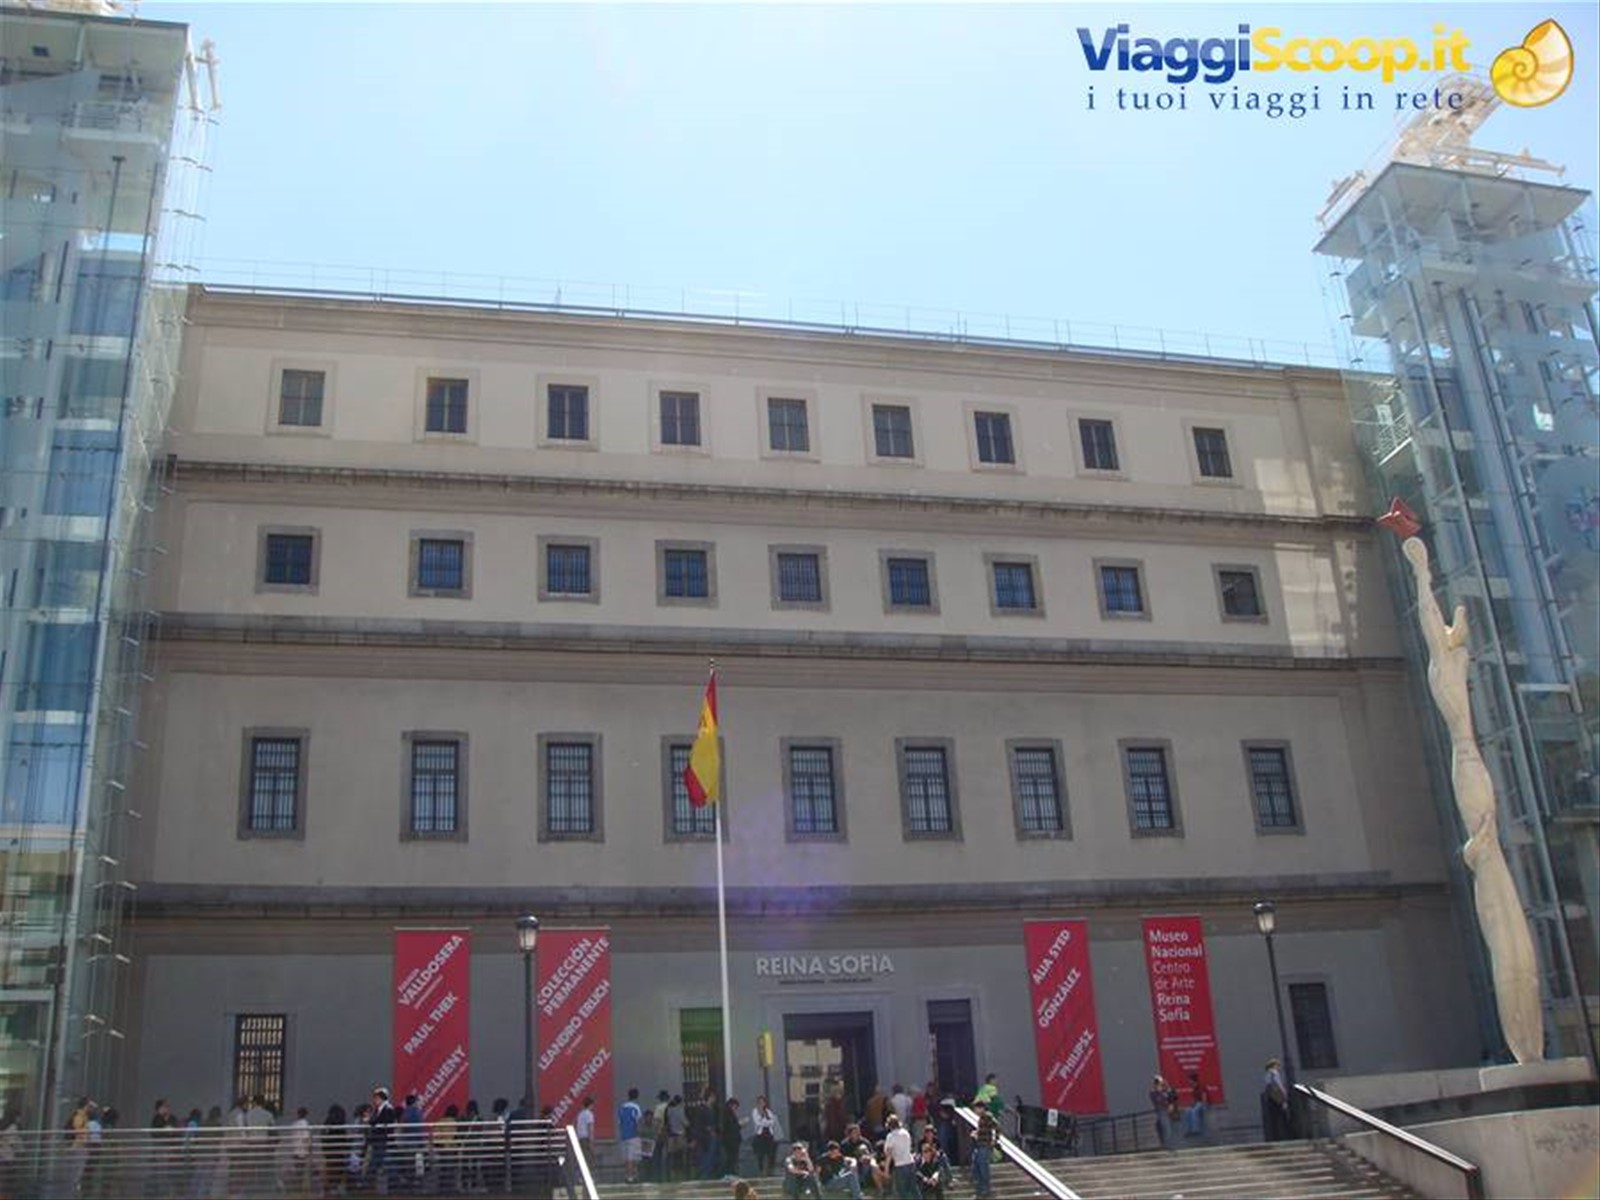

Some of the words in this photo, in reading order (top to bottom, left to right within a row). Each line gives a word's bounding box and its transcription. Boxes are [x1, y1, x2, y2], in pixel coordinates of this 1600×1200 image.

[1150, 930, 1189, 943] Museo
[1151, 944, 1202, 958] Nacional
[756, 956, 825, 976] REINA
[1153, 961, 1191, 974] Centro
[1155, 979, 1169, 990] de
[1172, 977, 1195, 989] Arte
[1158, 993, 1191, 1006] Reina
[403, 1022, 434, 1054] PAUL
[430, 991, 459, 1024] THEK
[538, 1016, 582, 1071] LEANDRO
